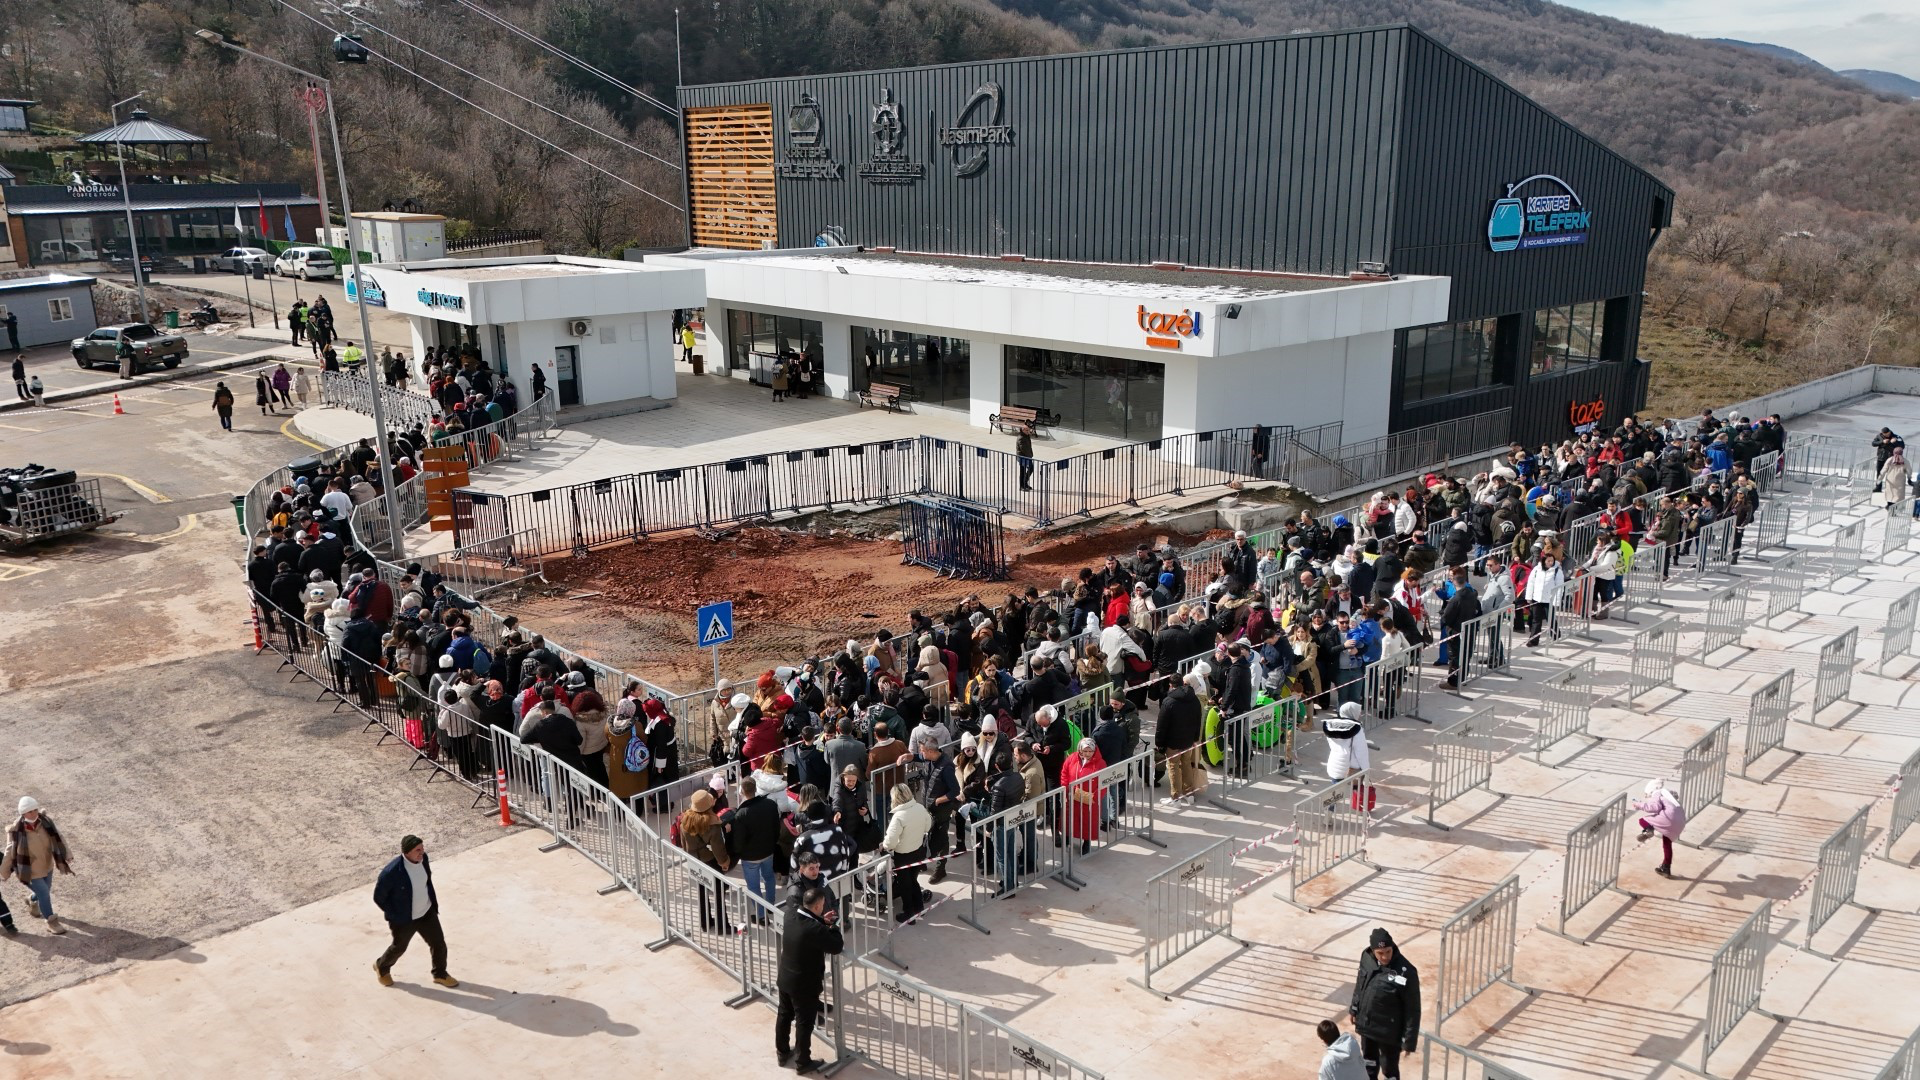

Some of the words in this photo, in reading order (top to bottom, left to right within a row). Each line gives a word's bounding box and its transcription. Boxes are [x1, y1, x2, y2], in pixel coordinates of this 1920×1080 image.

[785, 147, 827, 158] KARTEPE
[67, 185, 119, 193] PANORAMA
[1527, 195, 1570, 213] KARTEPE
